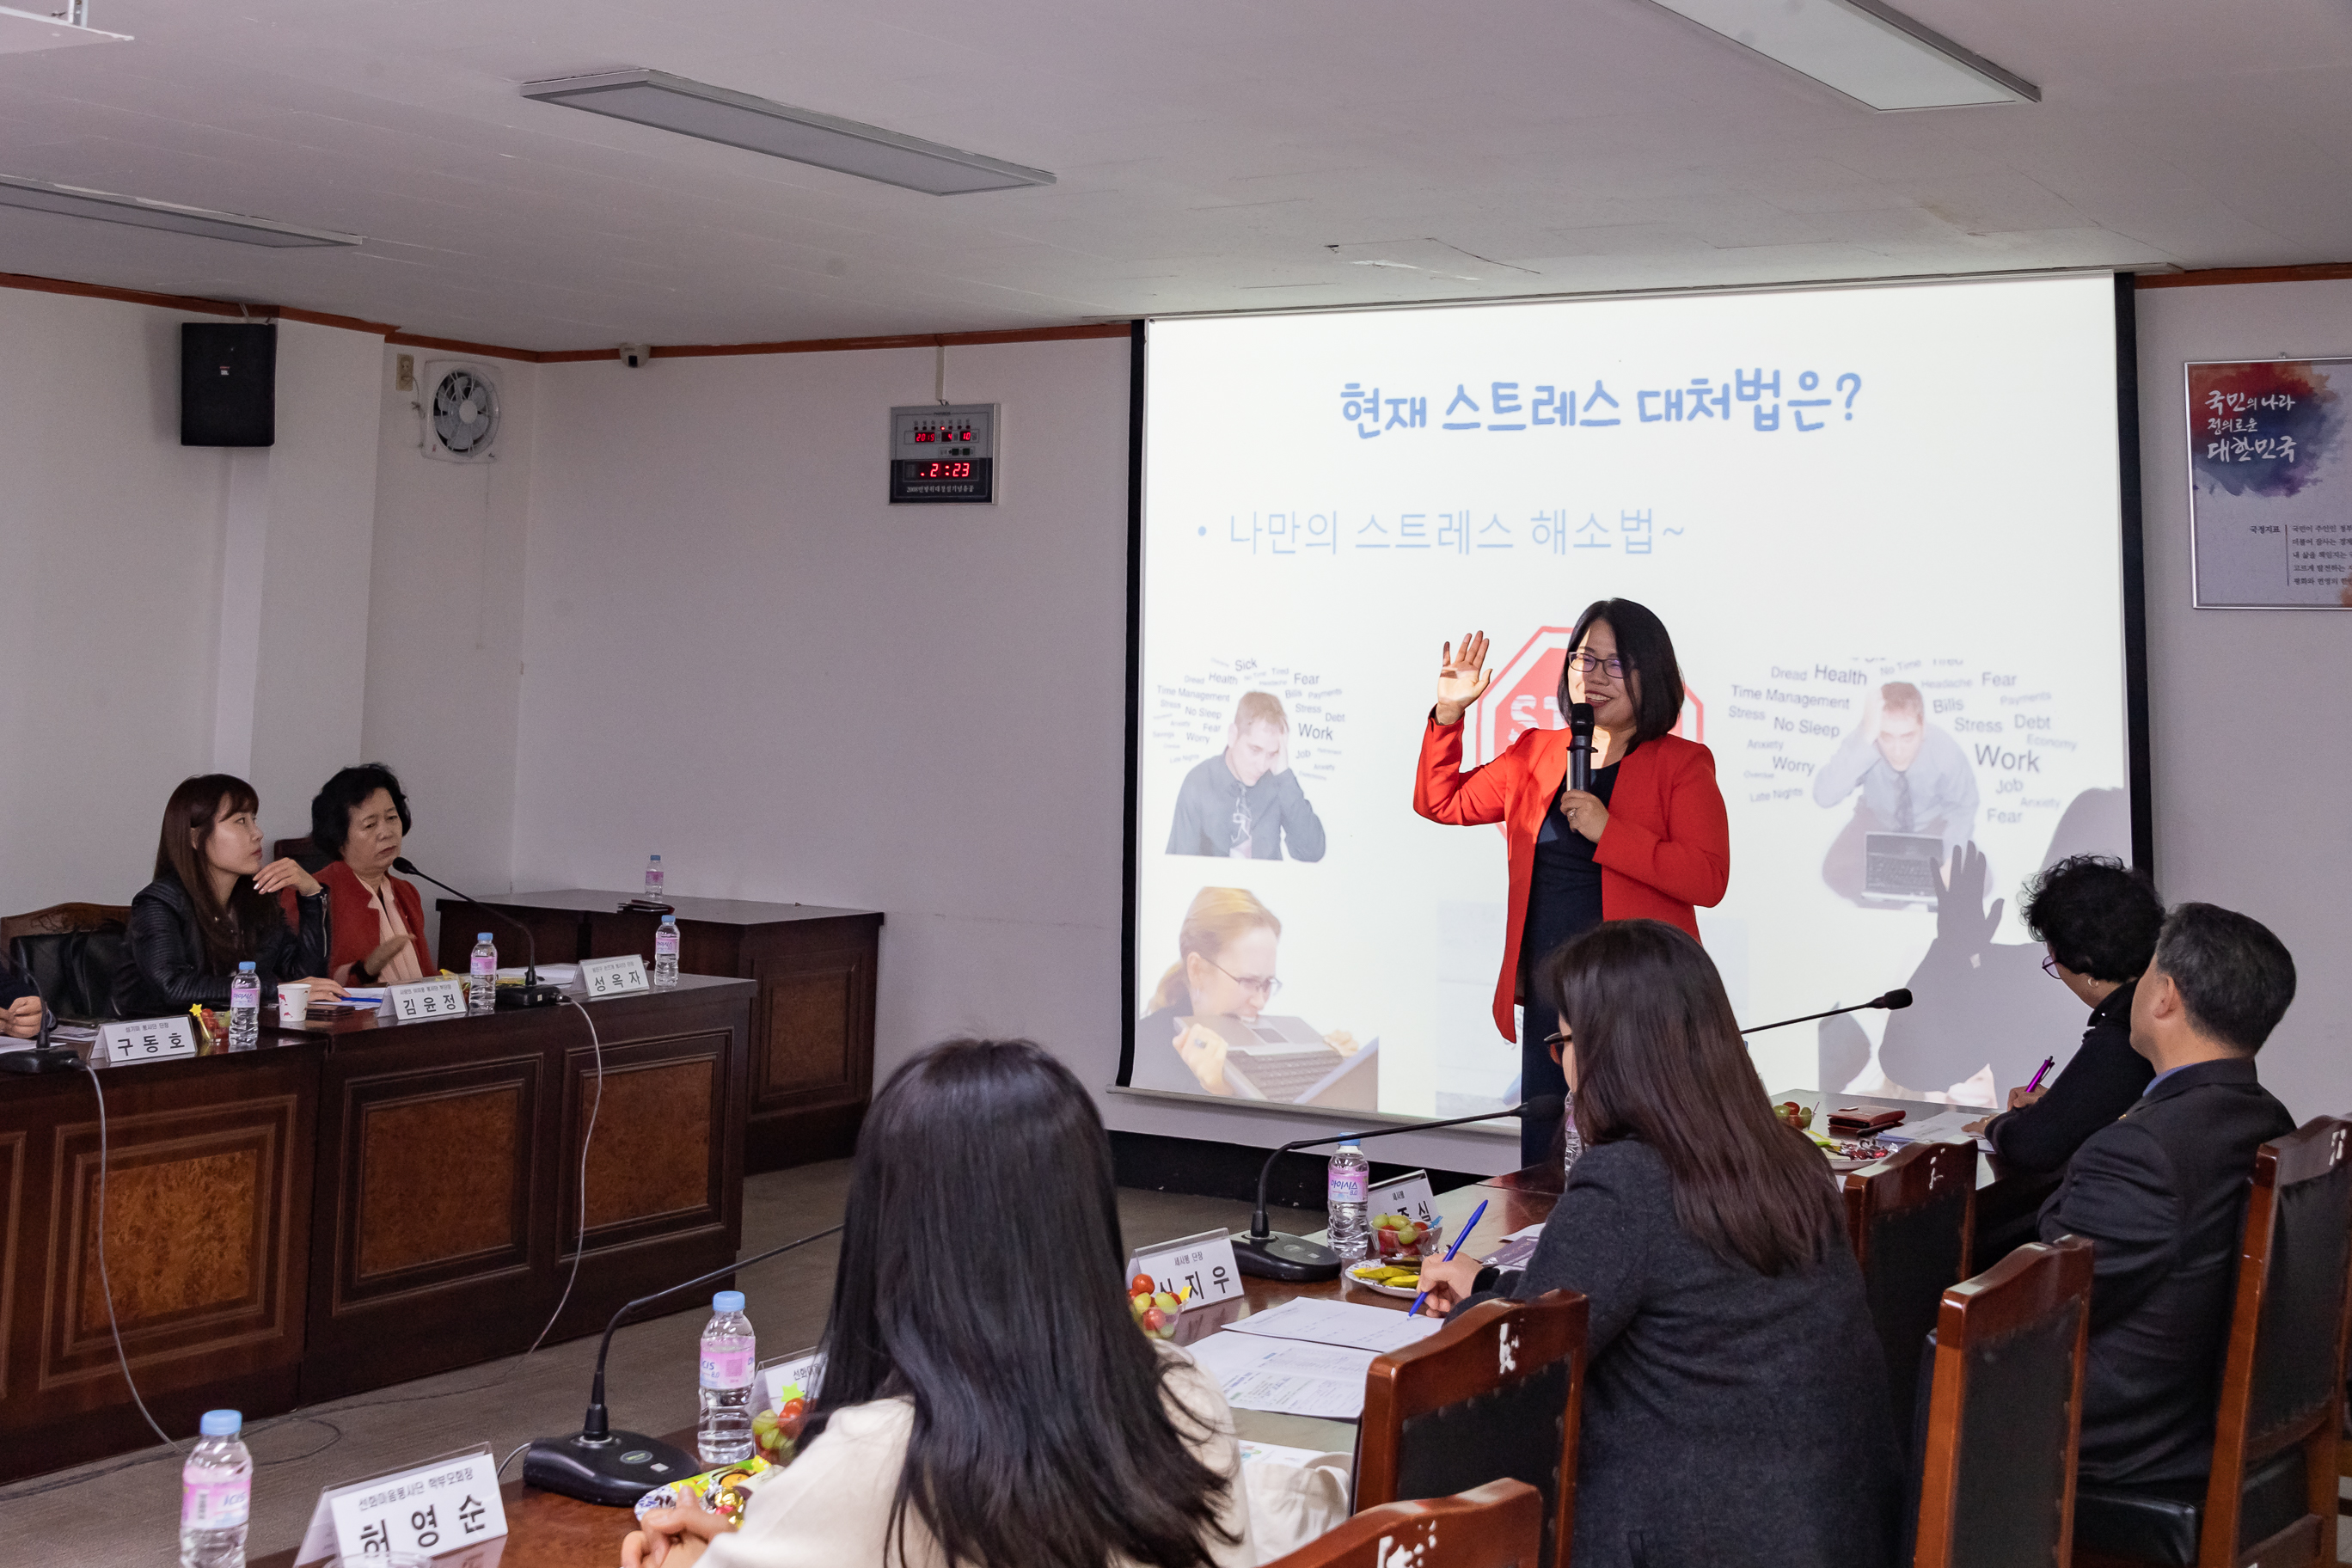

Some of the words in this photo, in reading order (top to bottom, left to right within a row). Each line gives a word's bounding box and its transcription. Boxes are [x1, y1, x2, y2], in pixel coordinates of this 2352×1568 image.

[1340, 383, 1427, 439] 현재
[1442, 380, 1621, 432] 스트레스
[1637, 367, 1863, 432] 대처법은?
[2205, 389, 2257, 415] 국민의
[2260, 394, 2296, 412] 나라
[2208, 418, 2258, 435] 정의로운
[2207, 436, 2297, 462] 대한민국
[1229, 511, 1338, 556] 나만의
[1355, 511, 1514, 556] 스트레스
[2249, 525, 2281, 534] 국정지표
[1235, 658, 1258, 671] Sick
[1271, 667, 1289, 676] Tired
[1184, 675, 1205, 684] Dread
[1209, 672, 1238, 685] Health
[1294, 673, 1320, 685] Fear
[1771, 666, 1807, 681] Dread
[1814, 664, 1868, 686] Health
[1981, 672, 2017, 686] Fear
[1157, 685, 1176, 696] Time
[1178, 687, 1231, 702] Management
[1285, 689, 1303, 699] Bills
[1308, 688, 1342, 700] Payments
[1731, 684, 1762, 700] Time
[1766, 689, 1850, 710] Management
[1160, 699, 1181, 709] Stress
[1295, 703, 1322, 713] Stress
[1933, 698, 1964, 714] Bills
[1185, 706, 1197, 716] No
[1199, 707, 1222, 720] Sleep
[1325, 712, 1345, 722] Debt
[1728, 705, 1766, 721] Stress
[1203, 723, 1221, 733] Fear
[1773, 716, 1795, 732] No
[1799, 719, 1841, 739] Sleep
[1954, 716, 2003, 733] Stress
[2014, 713, 2051, 730] Debt
[1186, 732, 1210, 745] Worry
[1298, 723, 1333, 741] Work
[1295, 749, 1311, 759] Job
[1975, 742, 2040, 774] Work
[1773, 755, 1816, 777] Worry
[1995, 778, 2024, 794] Job
[1987, 808, 2024, 824] Fear
[595, 970, 641, 992] 성옥자
[403, 994, 456, 1016] 김윤정
[118, 1032, 185, 1056] 구동호
